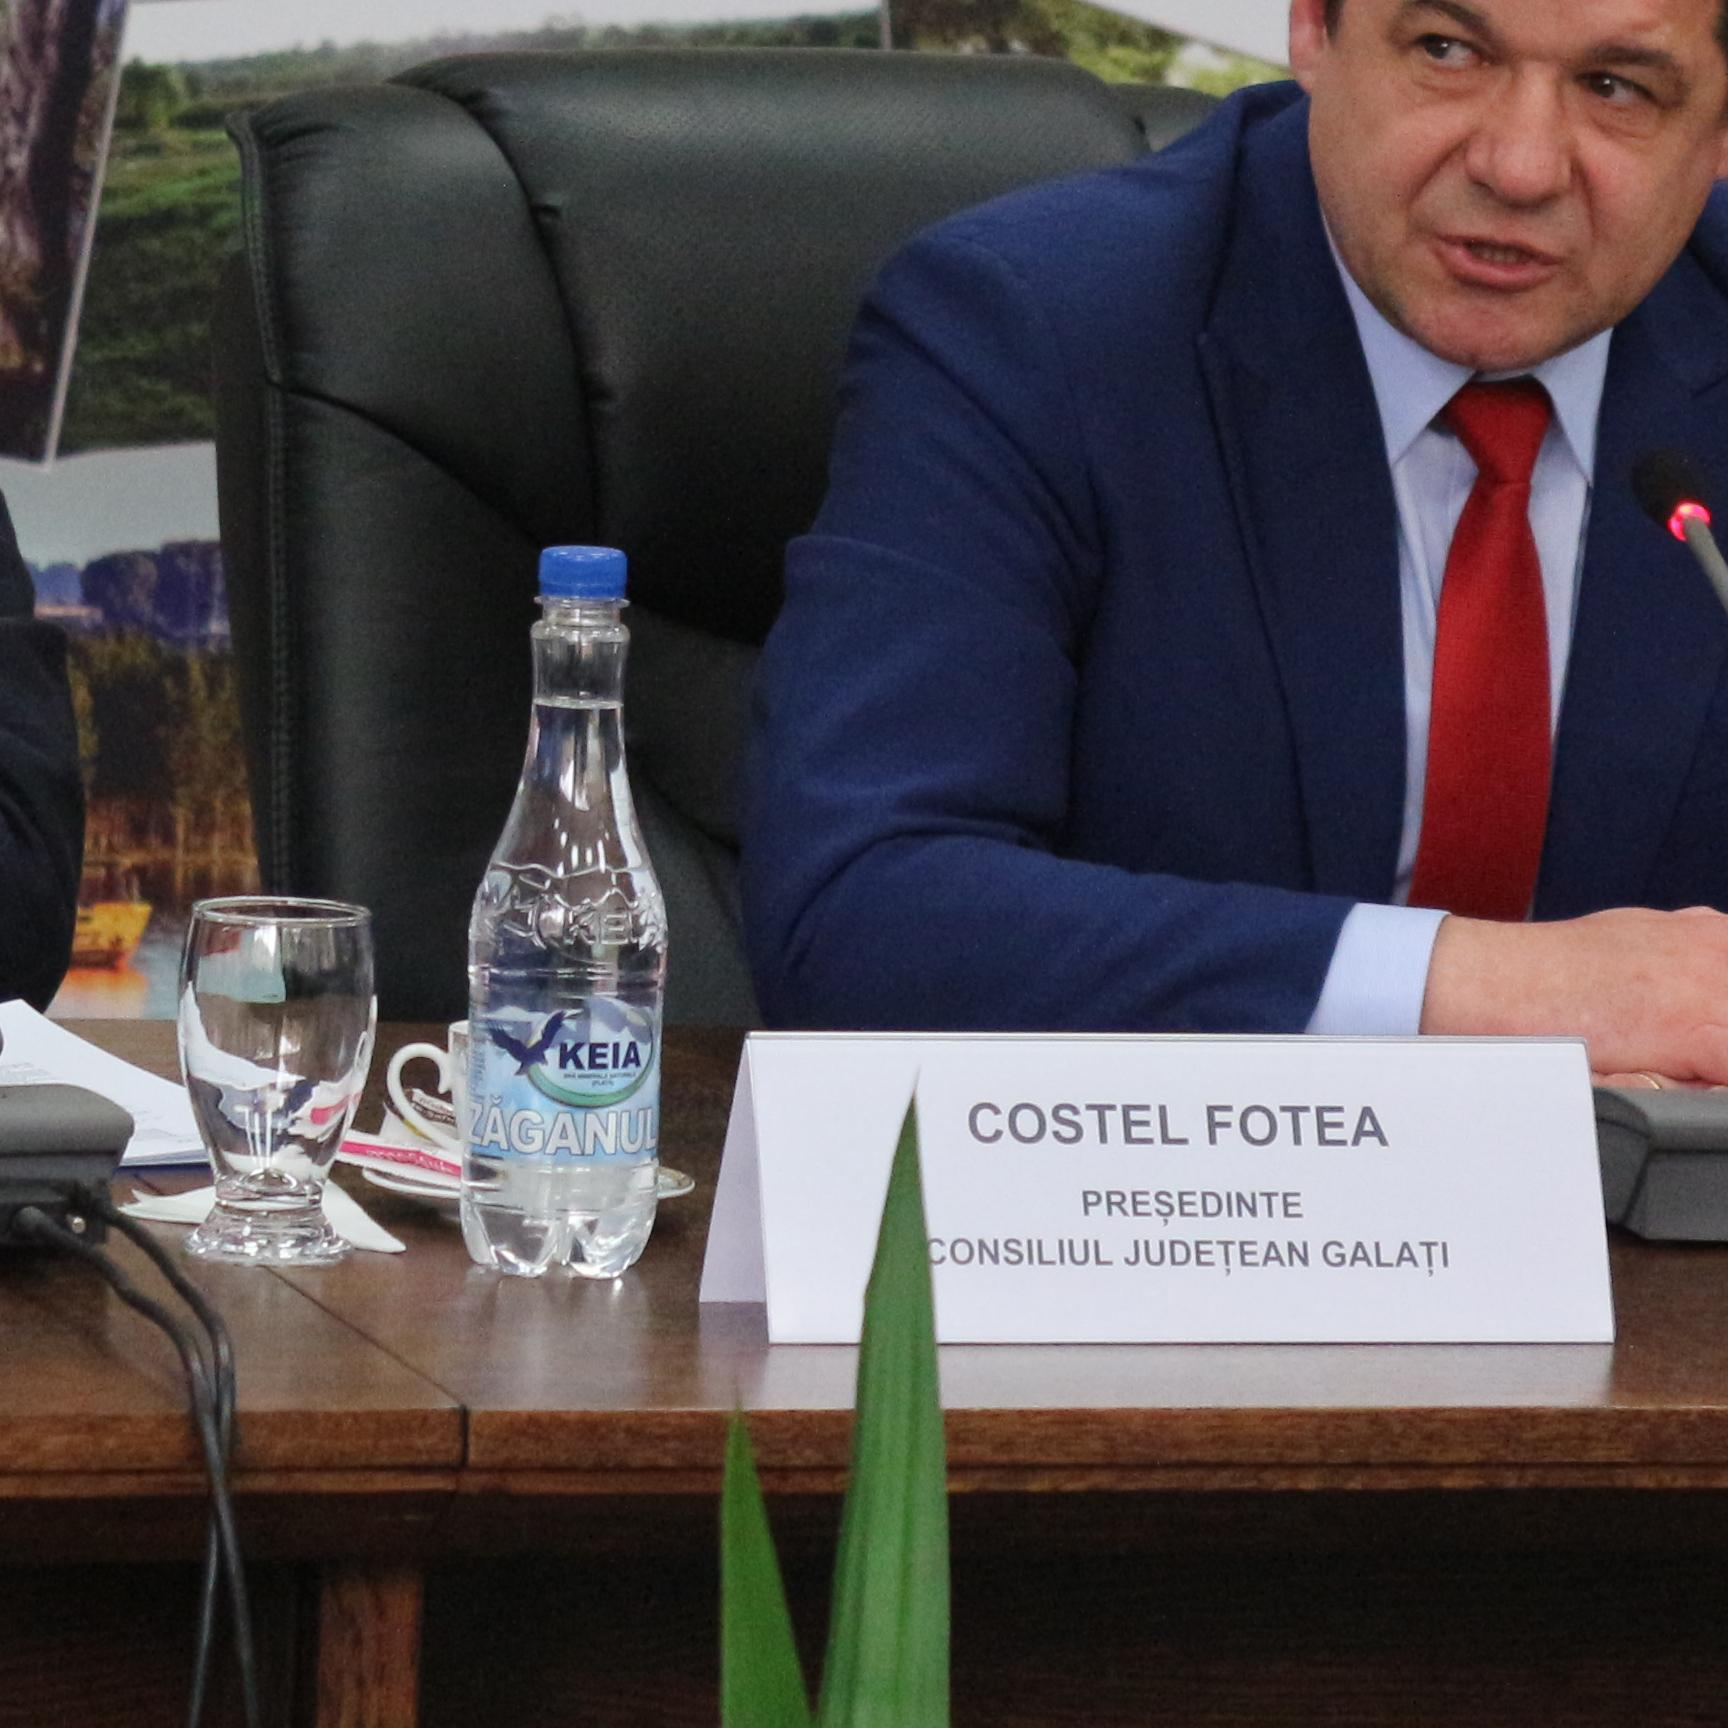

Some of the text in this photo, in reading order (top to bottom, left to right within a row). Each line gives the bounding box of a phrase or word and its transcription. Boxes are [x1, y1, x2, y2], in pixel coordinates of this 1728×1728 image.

[559, 1041, 641, 1070] KEIA
[469, 1095, 658, 1157] ZĂGANUL
[968, 1102, 1389, 1147] COSTEL FOTEA
[1082, 1190, 1303, 1226] PREȘEDINTE
[929, 1238, 1450, 1276] CONSILIUL JUDEȚEAN GALAȚI
